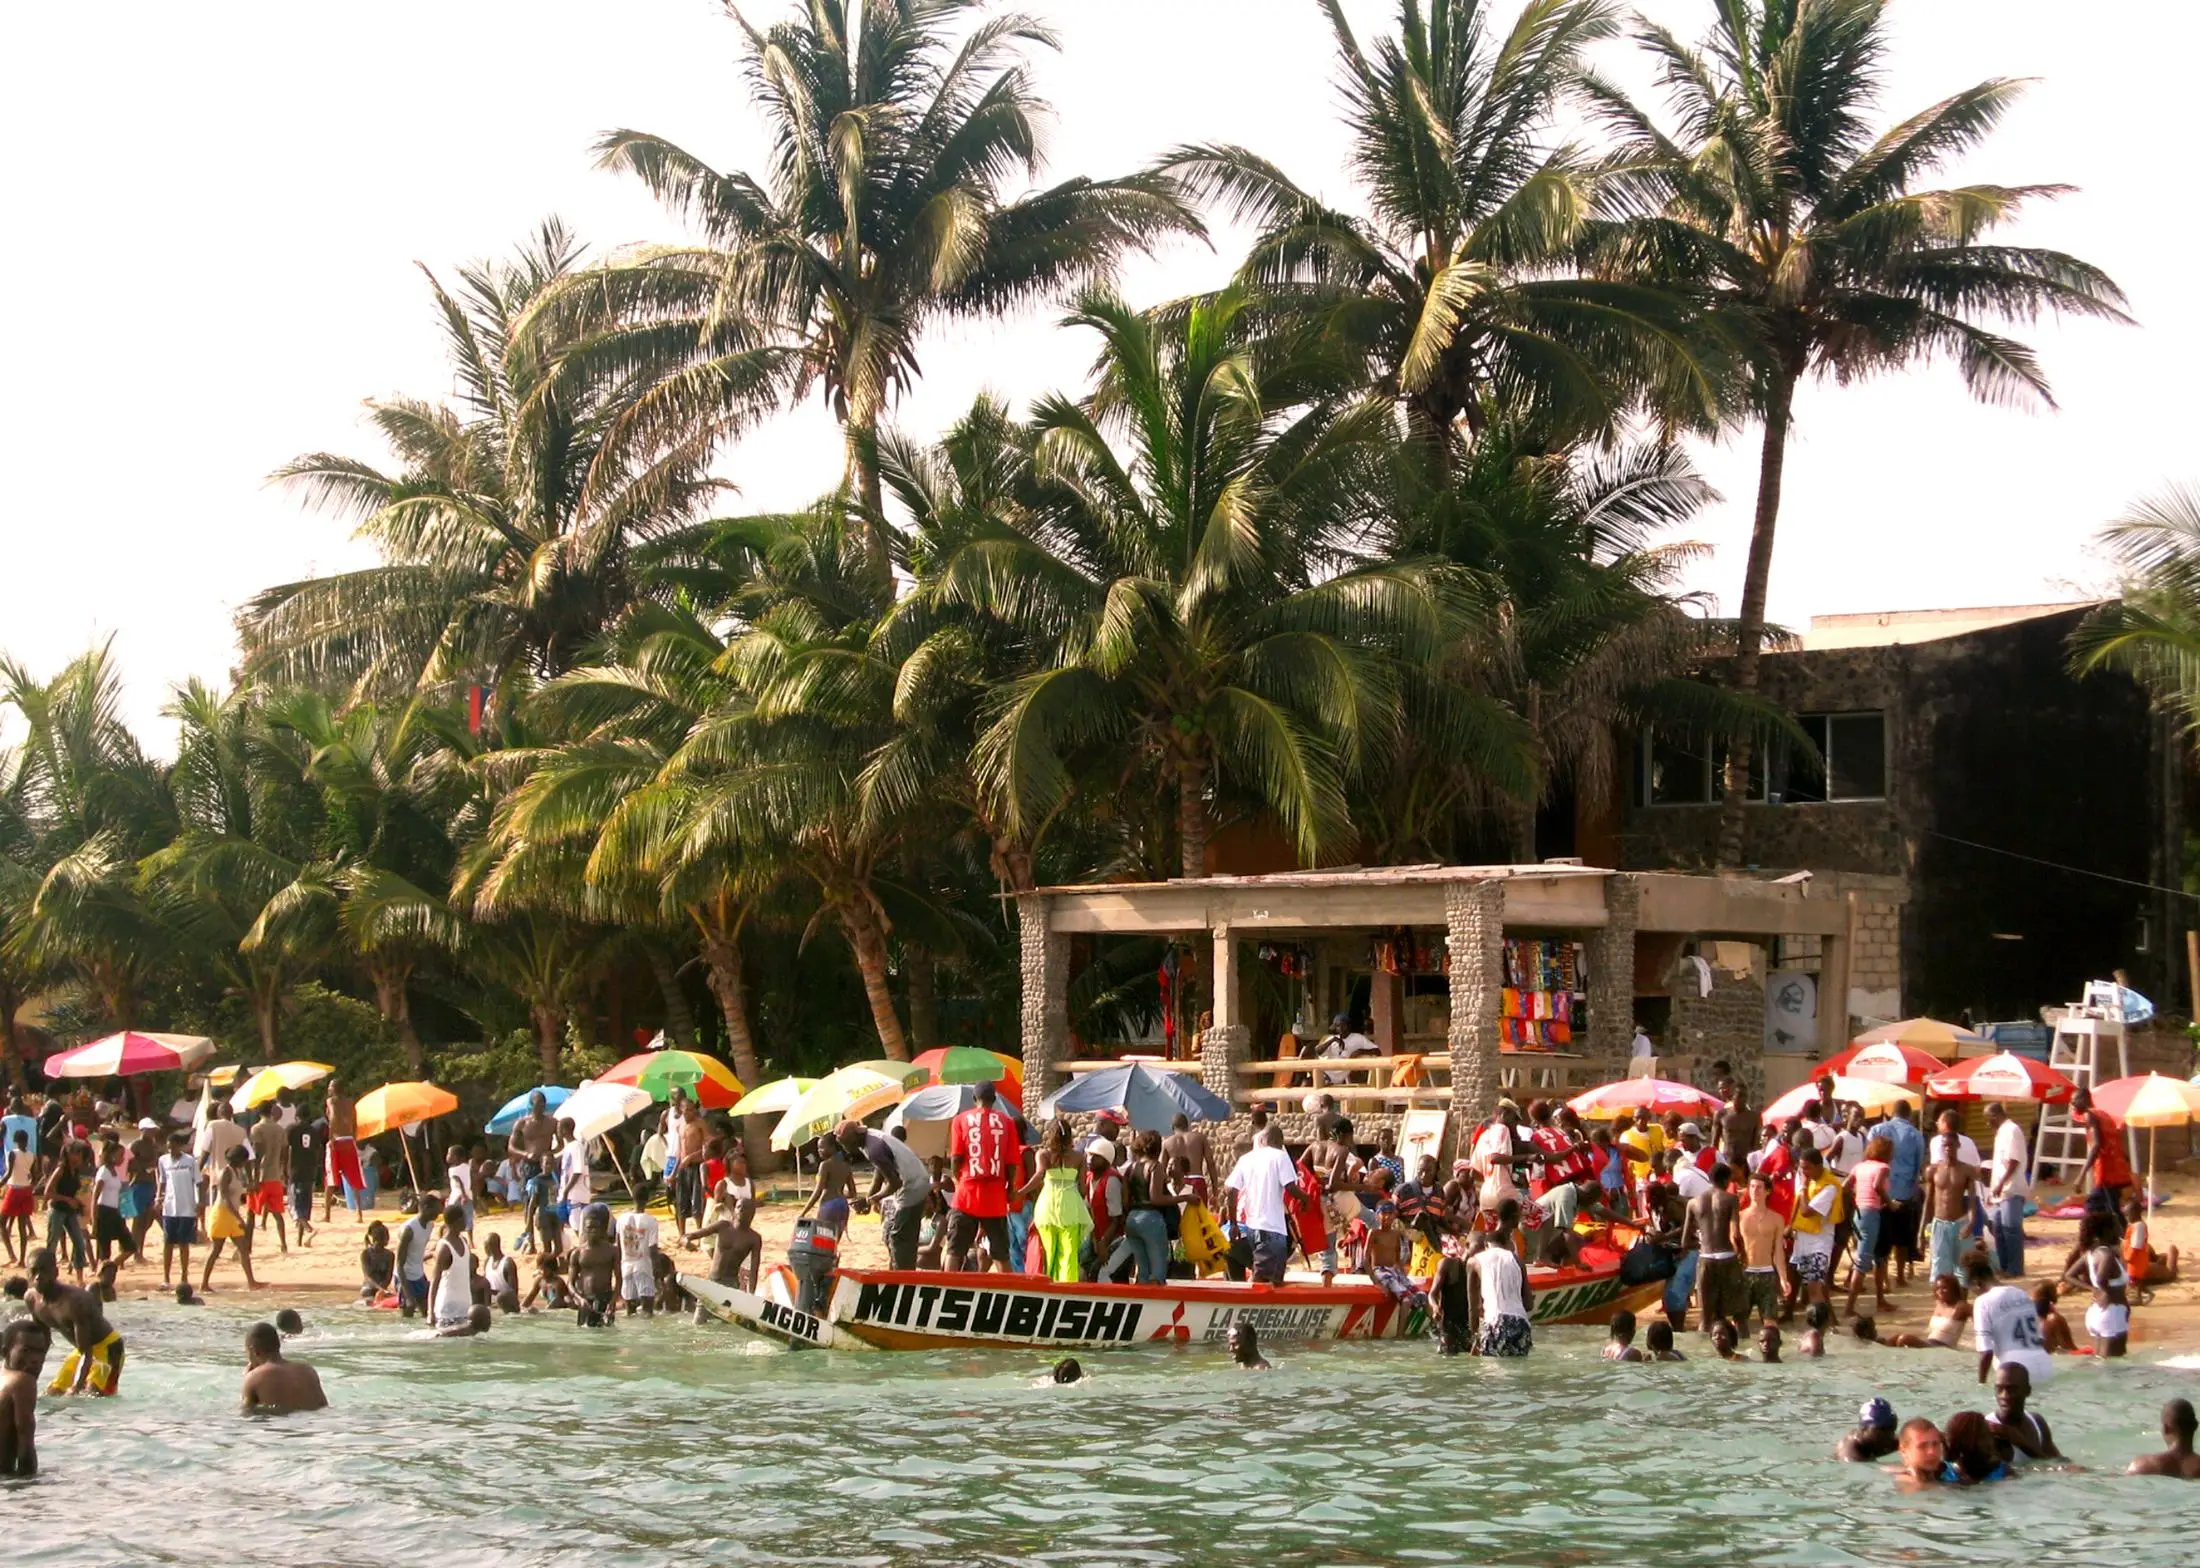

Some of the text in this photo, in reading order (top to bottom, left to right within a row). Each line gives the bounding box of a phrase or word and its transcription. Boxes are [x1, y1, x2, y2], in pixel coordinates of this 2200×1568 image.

[966, 1112, 984, 1177] NGOR
[760, 1299, 820, 1342] NGOR
[854, 1283, 1144, 1342] MITSUBISHI
[1208, 1307, 1333, 1329] LA SENEGALAISE
